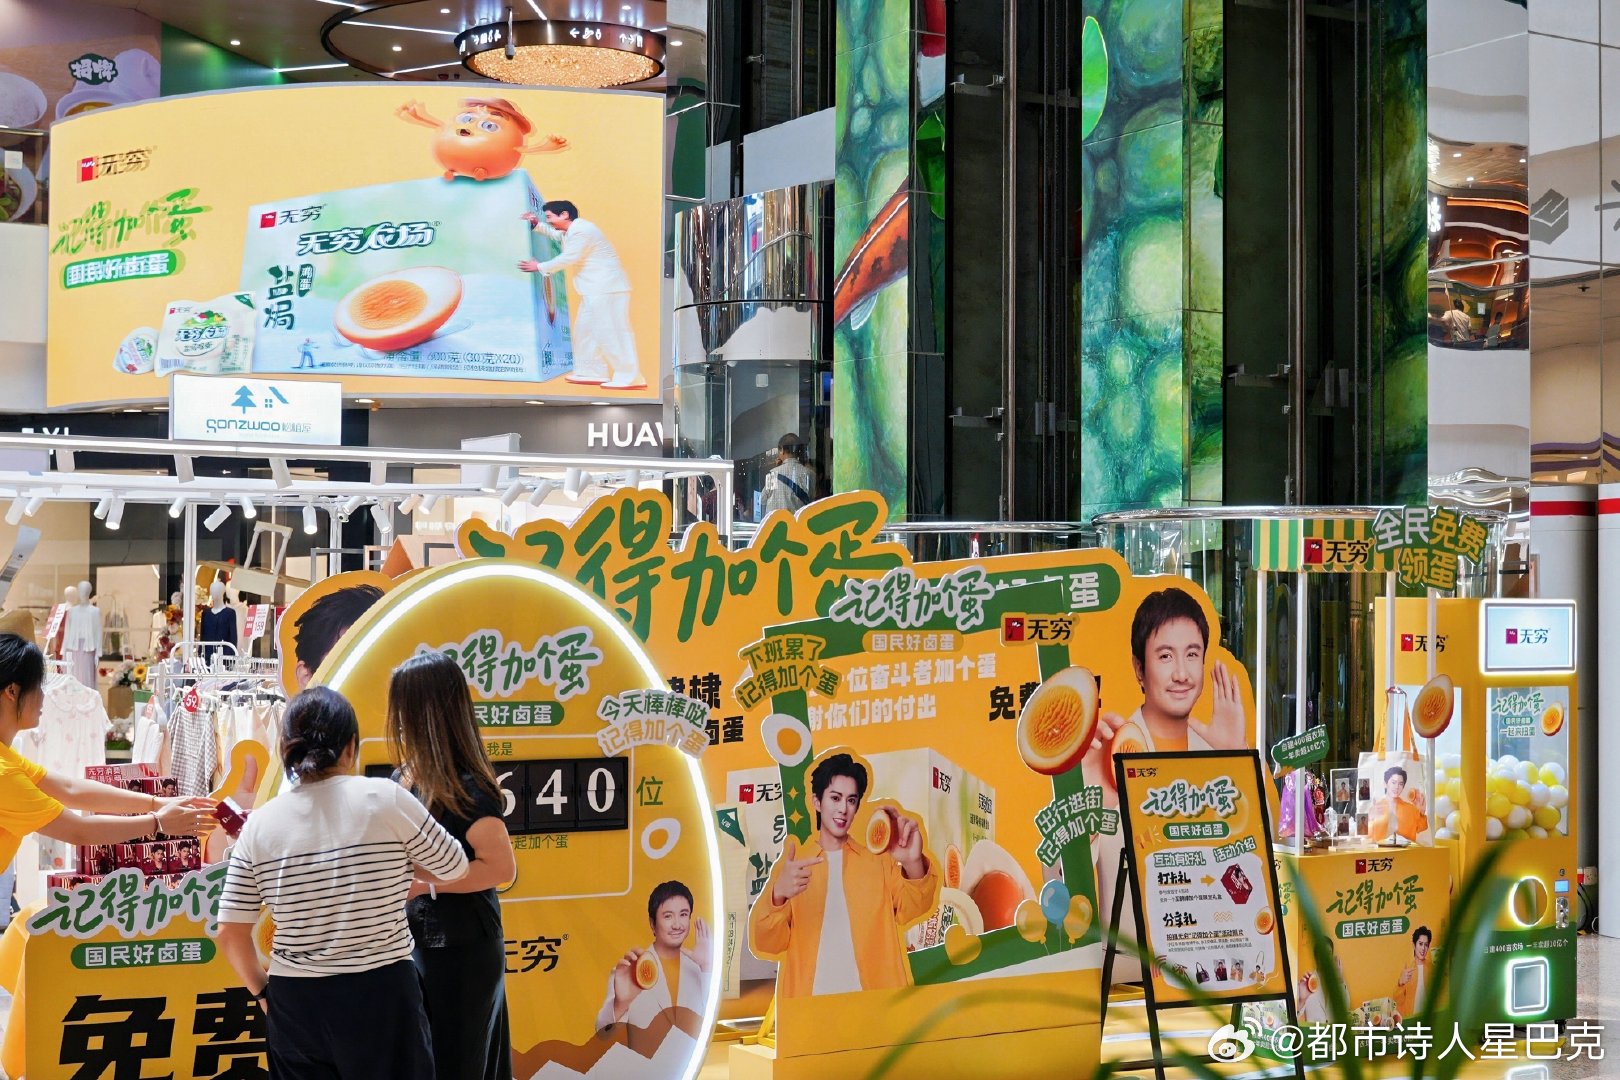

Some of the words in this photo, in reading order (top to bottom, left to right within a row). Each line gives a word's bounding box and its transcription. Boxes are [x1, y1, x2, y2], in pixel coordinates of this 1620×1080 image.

[279, 205, 324, 225] 无穷
[297, 221, 436, 256] 无穷农场
[1374, 508, 1486, 562] 全民免费
[1326, 540, 1369, 563] 无穷
[1401, 548, 1457, 589] 领蛋
[836, 570, 991, 627] 记得加个蛋
[1028, 618, 1072, 640] 无穷
[1520, 628, 1550, 645] 无穷
[743, 637, 823, 670] 下班累了
[872, 633, 955, 651] 国民好卤蛋
[1415, 635, 1446, 652] 无穷
[421, 633, 598, 695] 得加个蛋
[842, 653, 997, 693] 位奋斗者加个蛋
[738, 665, 839, 708] 记得加个蛋
[602, 692, 708, 729] 今天棒棒哒
[1492, 692, 1544, 714] 记得加个蛋
[602, 718, 708, 754] 记得加个蛋
[1137, 767, 1157, 778] 无穷
[636, 776, 664, 806] 位
[1142, 779, 1236, 814] 记得加个蛋
[1038, 787, 1101, 835] 出行逛街
[510, 834, 568, 850] 起加个蛋
[1041, 812, 1117, 864] 记得加个蛋
[1169, 824, 1224, 837] 国民好卤蛋
[1154, 852, 1206, 867] 互动有好礼
[1213, 838, 1256, 862] 活动介绍
[1158, 871, 1191, 884] 打卡礼
[1368, 858, 1393, 872] 无穷
[1326, 875, 1424, 916] 记得加个蛋
[1163, 911, 1197, 928] 分享礼
[1342, 919, 1403, 937] 国民好卤蛋
[85, 942, 202, 967] 国民好卤蛋
[59, 986, 268, 1080] 免费
